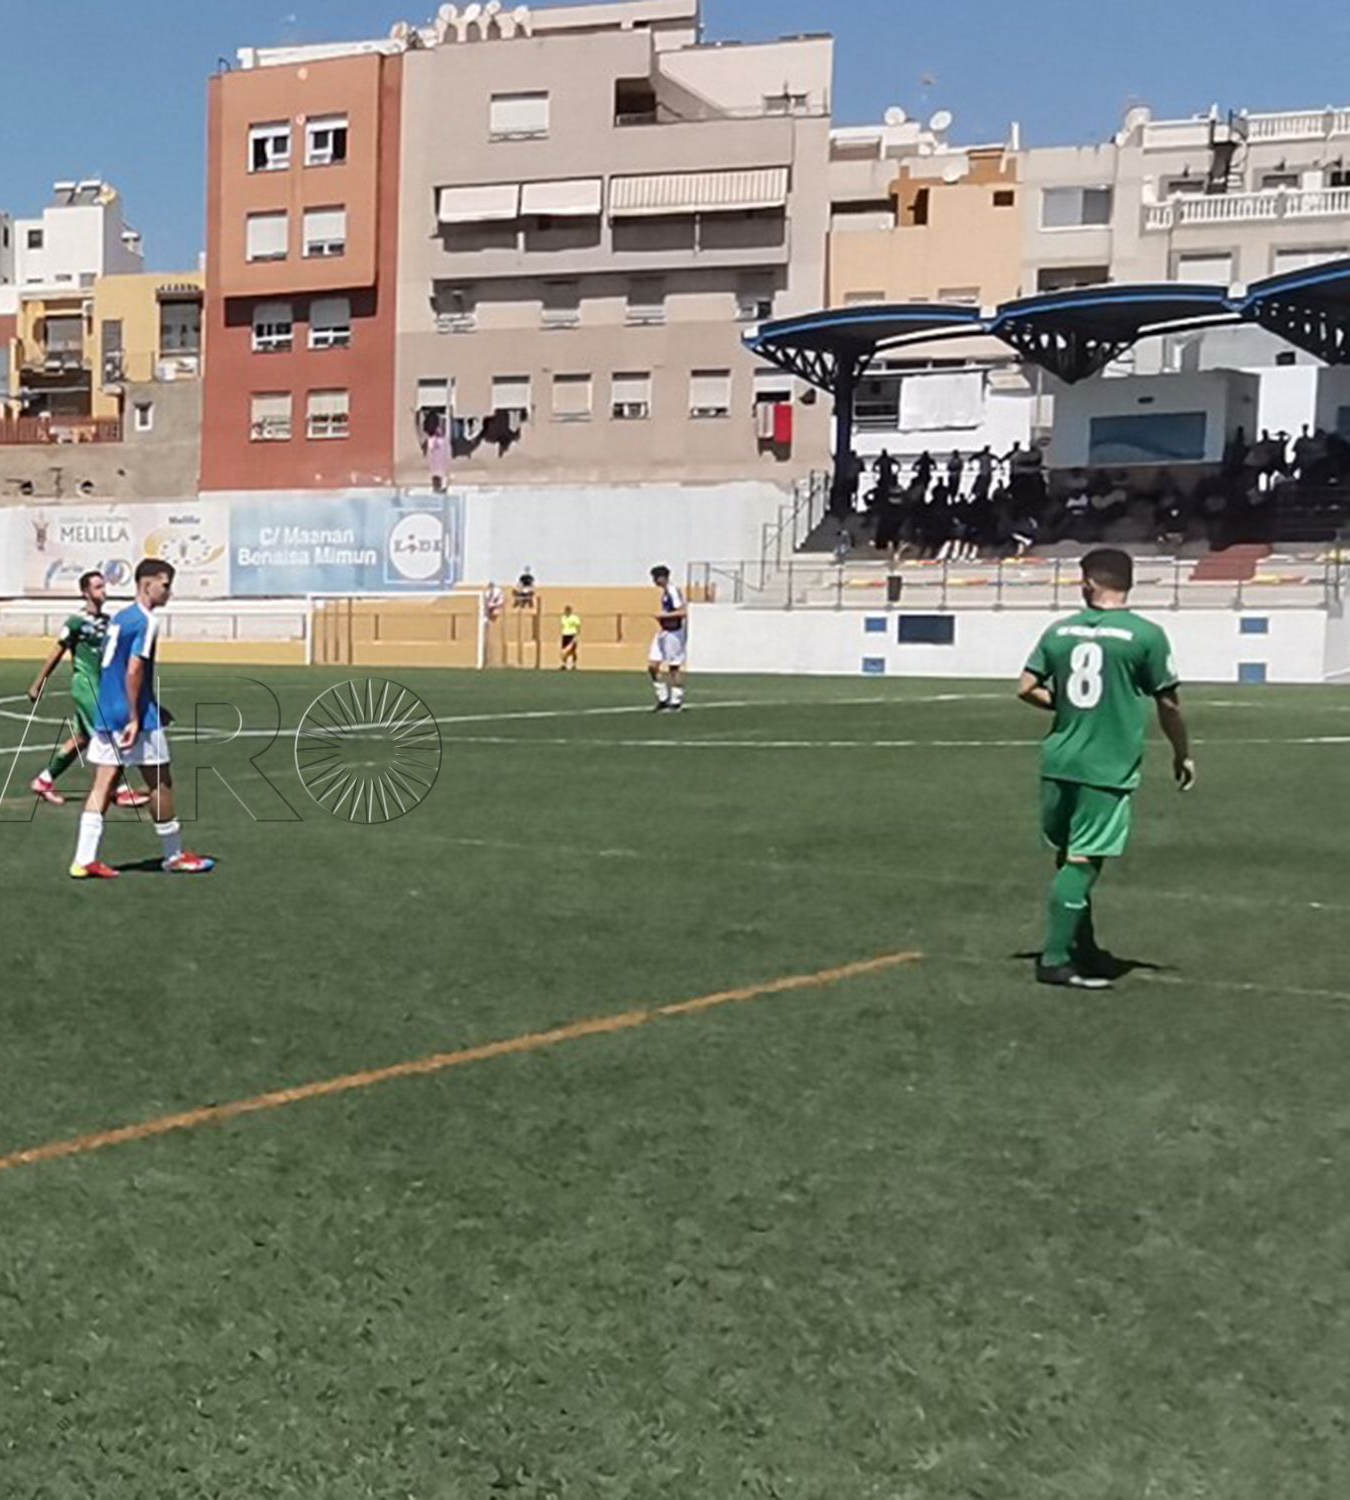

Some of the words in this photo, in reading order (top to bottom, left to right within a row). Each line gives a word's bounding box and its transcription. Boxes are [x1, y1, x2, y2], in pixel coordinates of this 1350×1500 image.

[60, 525, 130, 543] MELILLA
[260, 526, 280, 546] C/
[314, 546, 377, 565] Mimun
[1066, 641, 1103, 709] 8
